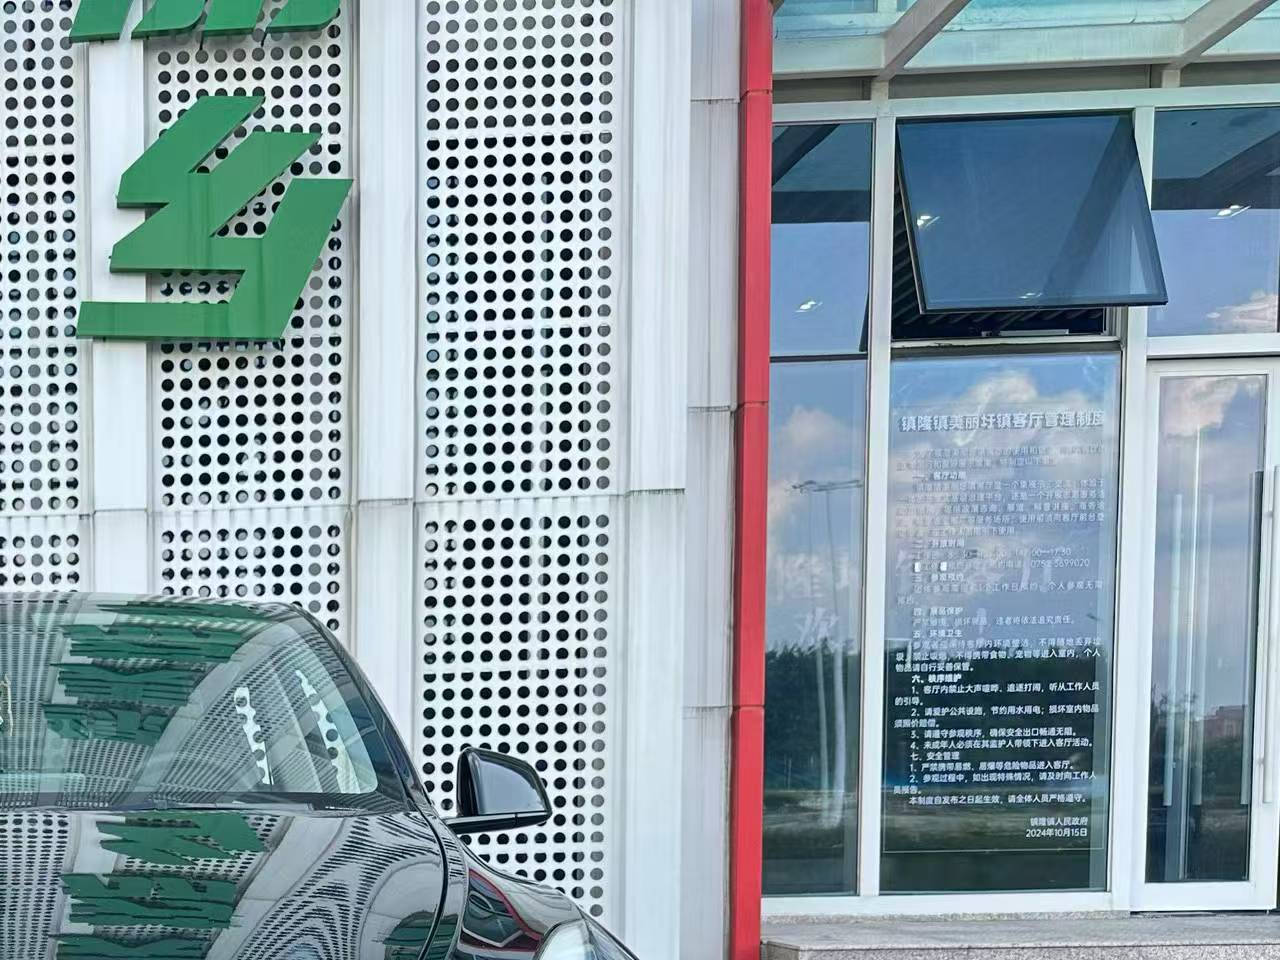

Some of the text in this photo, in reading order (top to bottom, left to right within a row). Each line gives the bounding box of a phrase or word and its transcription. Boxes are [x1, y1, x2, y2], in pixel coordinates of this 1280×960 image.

[69, 0, 354, 340] 乡
[901, 410, 1104, 432] 镇隆镇美丽圩镇客厅管理制度
[1025, 828, 1088, 838] 2024年10月15日
